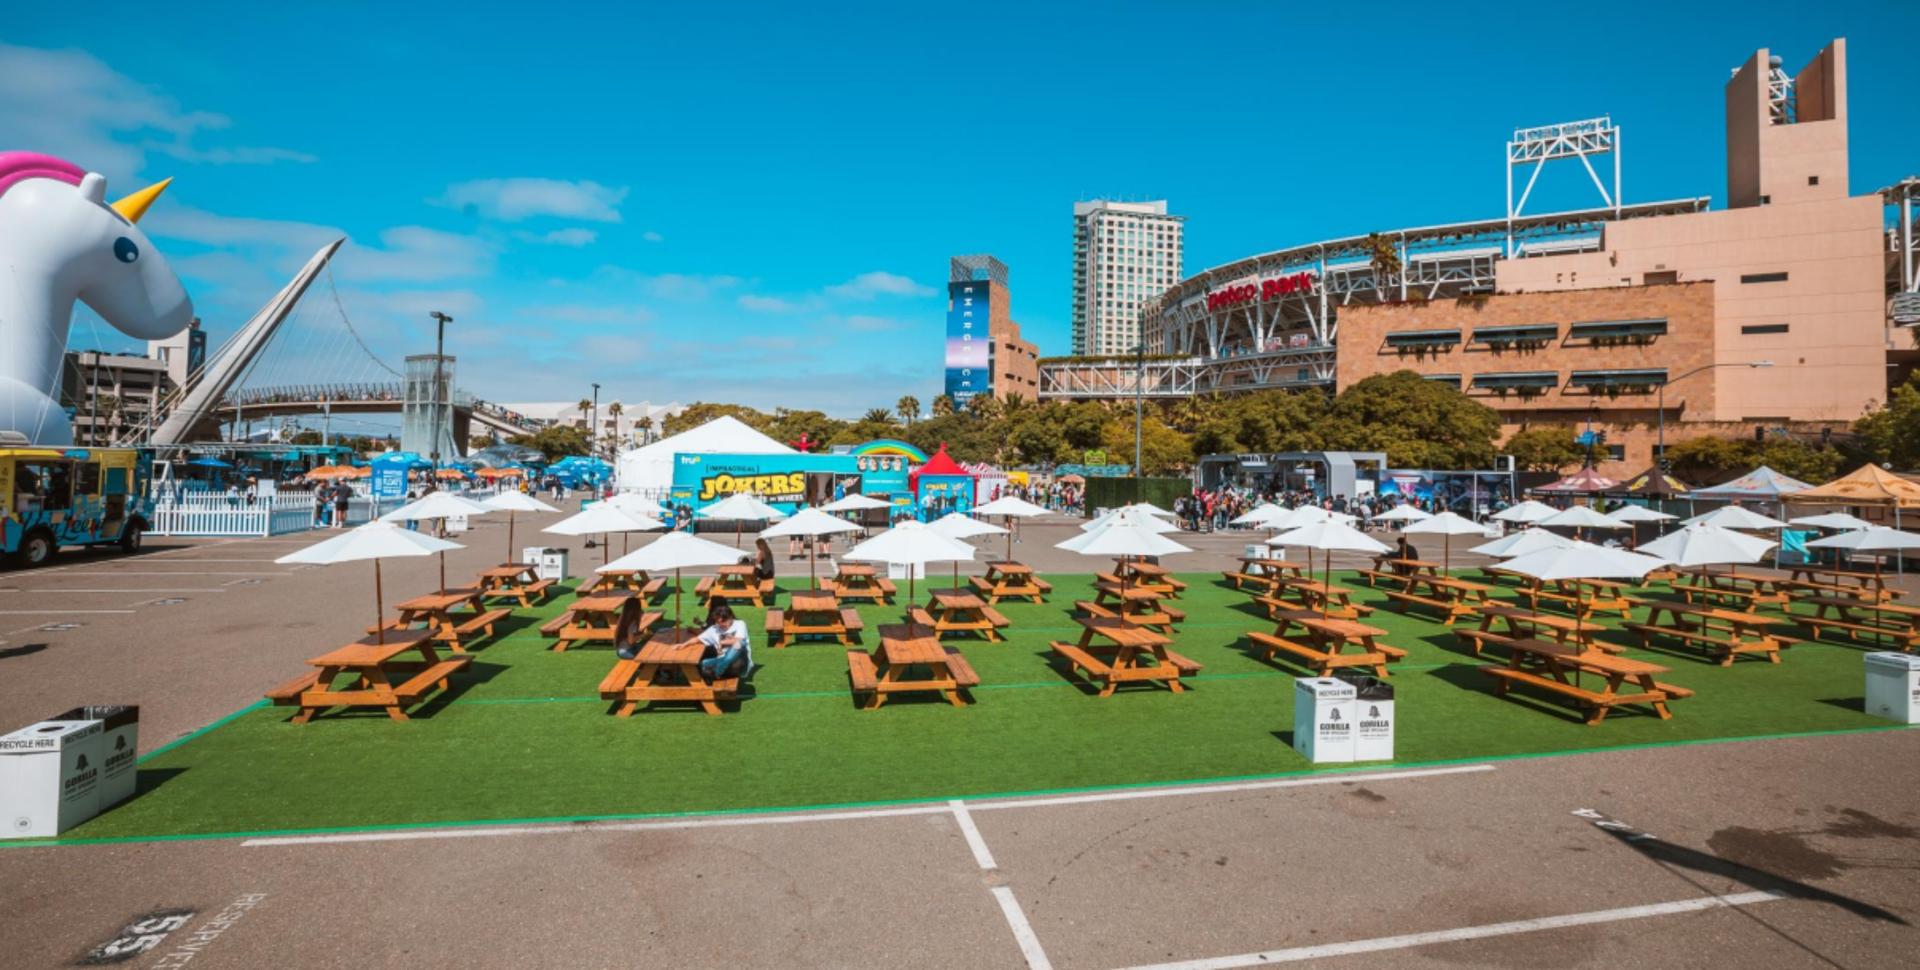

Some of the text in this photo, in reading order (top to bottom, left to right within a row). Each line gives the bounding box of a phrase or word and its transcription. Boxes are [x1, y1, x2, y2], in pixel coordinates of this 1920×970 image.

[1262, 272, 1312, 301] park
[963, 287, 973, 387] EMERGECE
[700, 473, 805, 500] JOKERS
[1320, 723, 1350, 731] GORILLA
[1360, 720, 1389, 728] GORILLA
[35, 739, 55, 748] HERE
[65, 768, 97, 789] GORILLA
